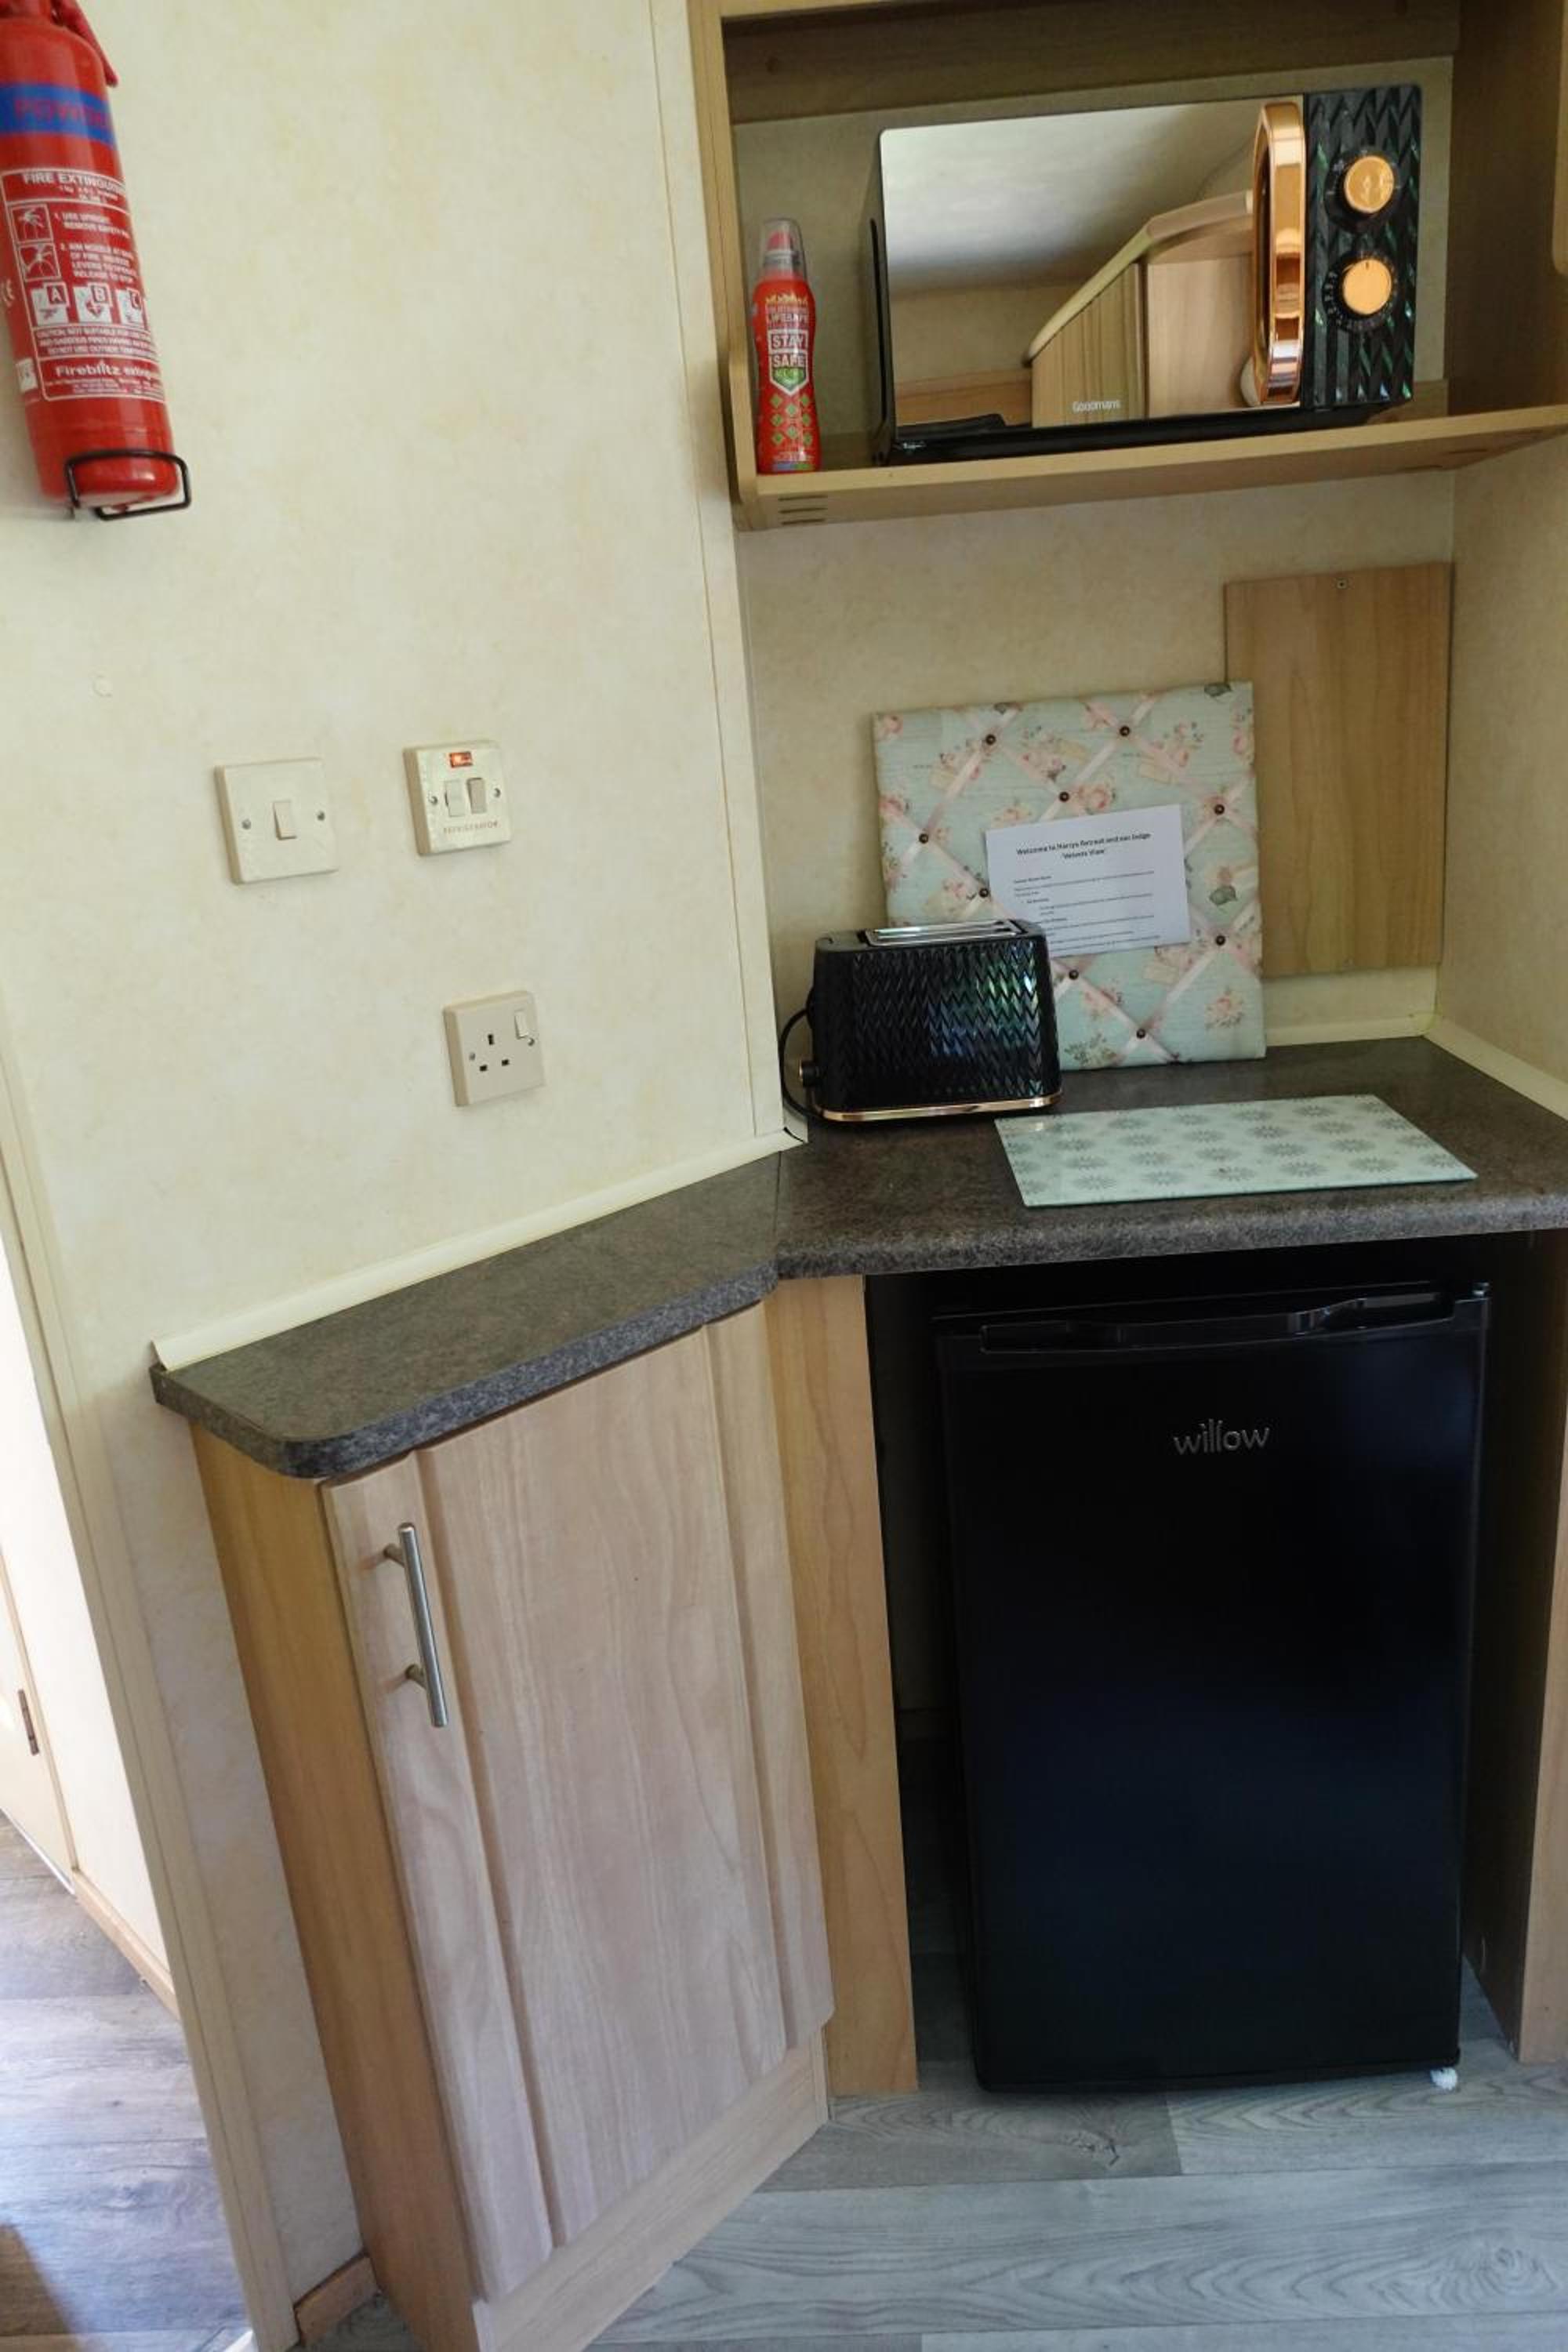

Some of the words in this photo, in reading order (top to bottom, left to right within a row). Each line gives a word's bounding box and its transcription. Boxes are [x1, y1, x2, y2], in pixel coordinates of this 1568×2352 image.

[22, 173, 54, 185] FIRE
[50, 289, 63, 302] A
[94, 287, 107, 302] B
[772, 334, 804, 349] STAY
[773, 354, 805, 368] SAFE
[55, 360, 121, 377] Fireblitz
[1017, 846, 1047, 855] Welcome
[1172, 1418, 1271, 1456] willow
